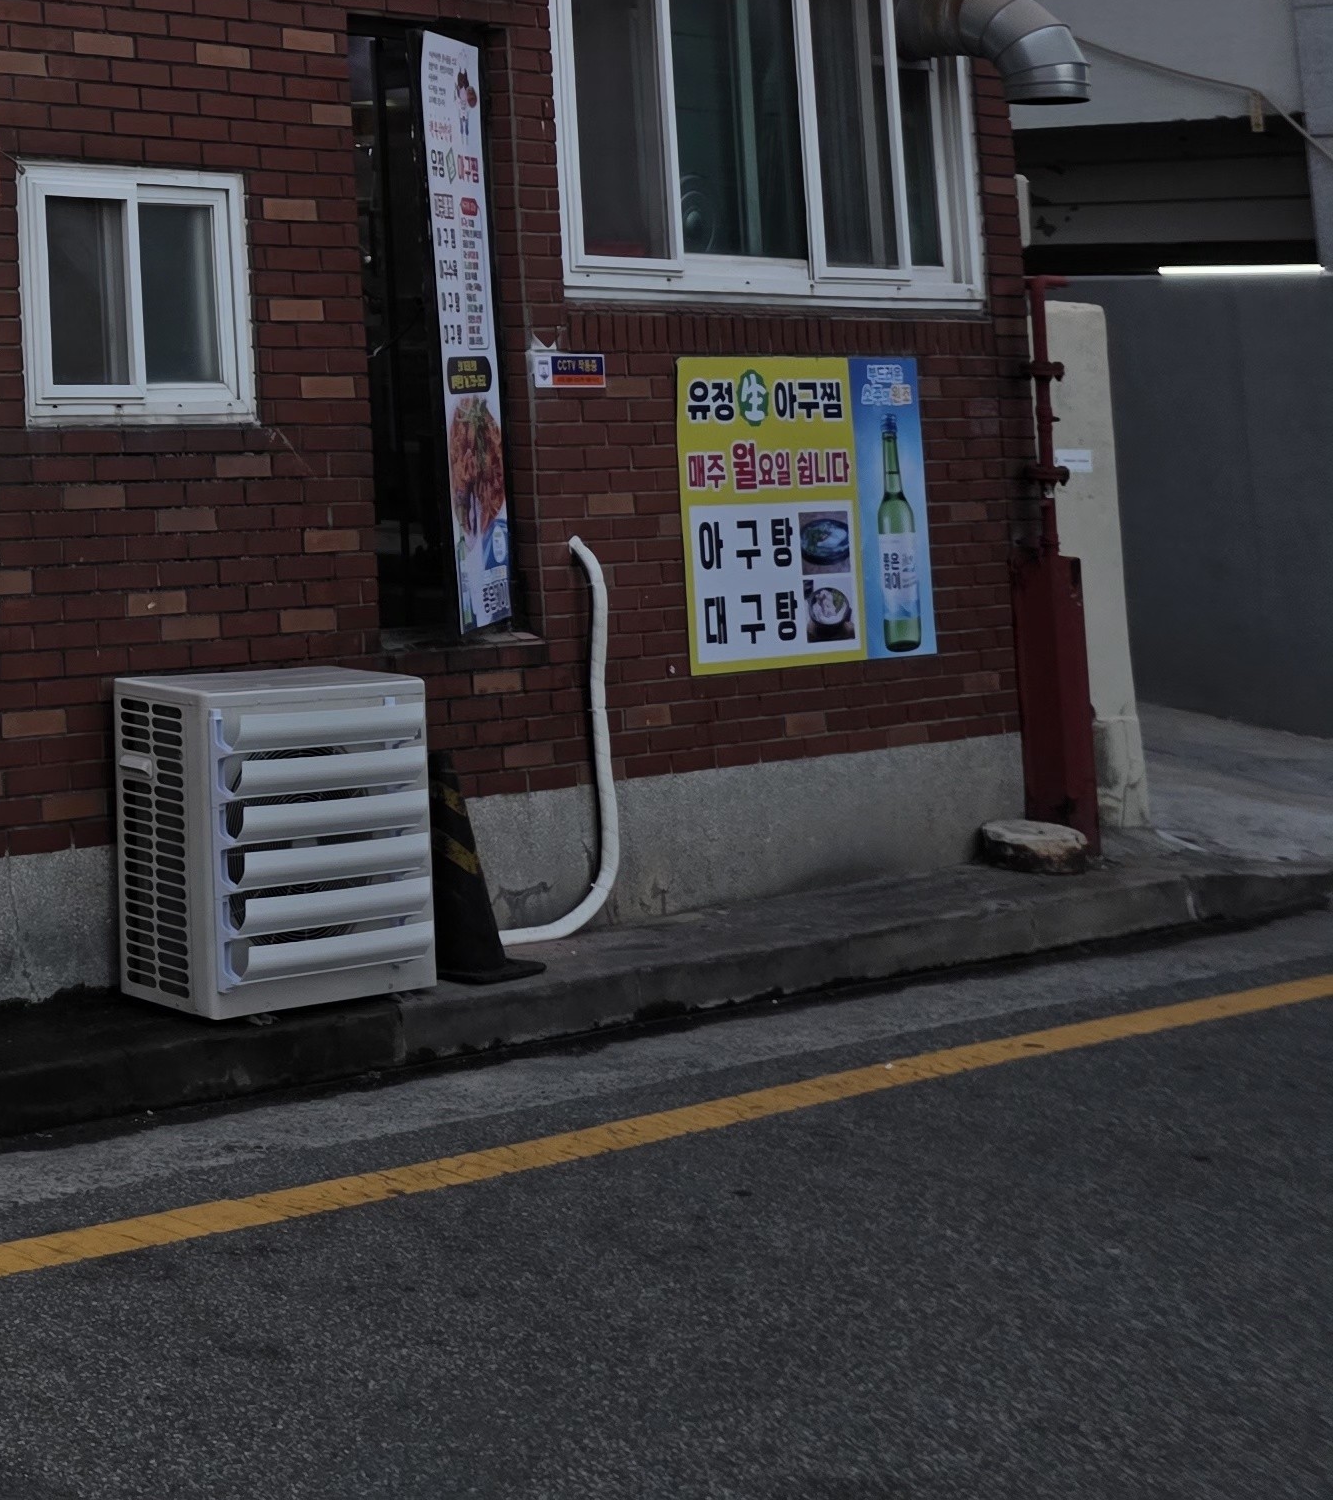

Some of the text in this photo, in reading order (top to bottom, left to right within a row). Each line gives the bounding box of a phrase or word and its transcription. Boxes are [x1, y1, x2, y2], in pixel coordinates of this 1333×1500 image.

[557, 359, 576, 371] CCTV
[688, 381, 735, 421] 유정
[774, 382, 843, 419] 아구찜
[688, 442, 850, 490] 매주 월요일 쉽니다
